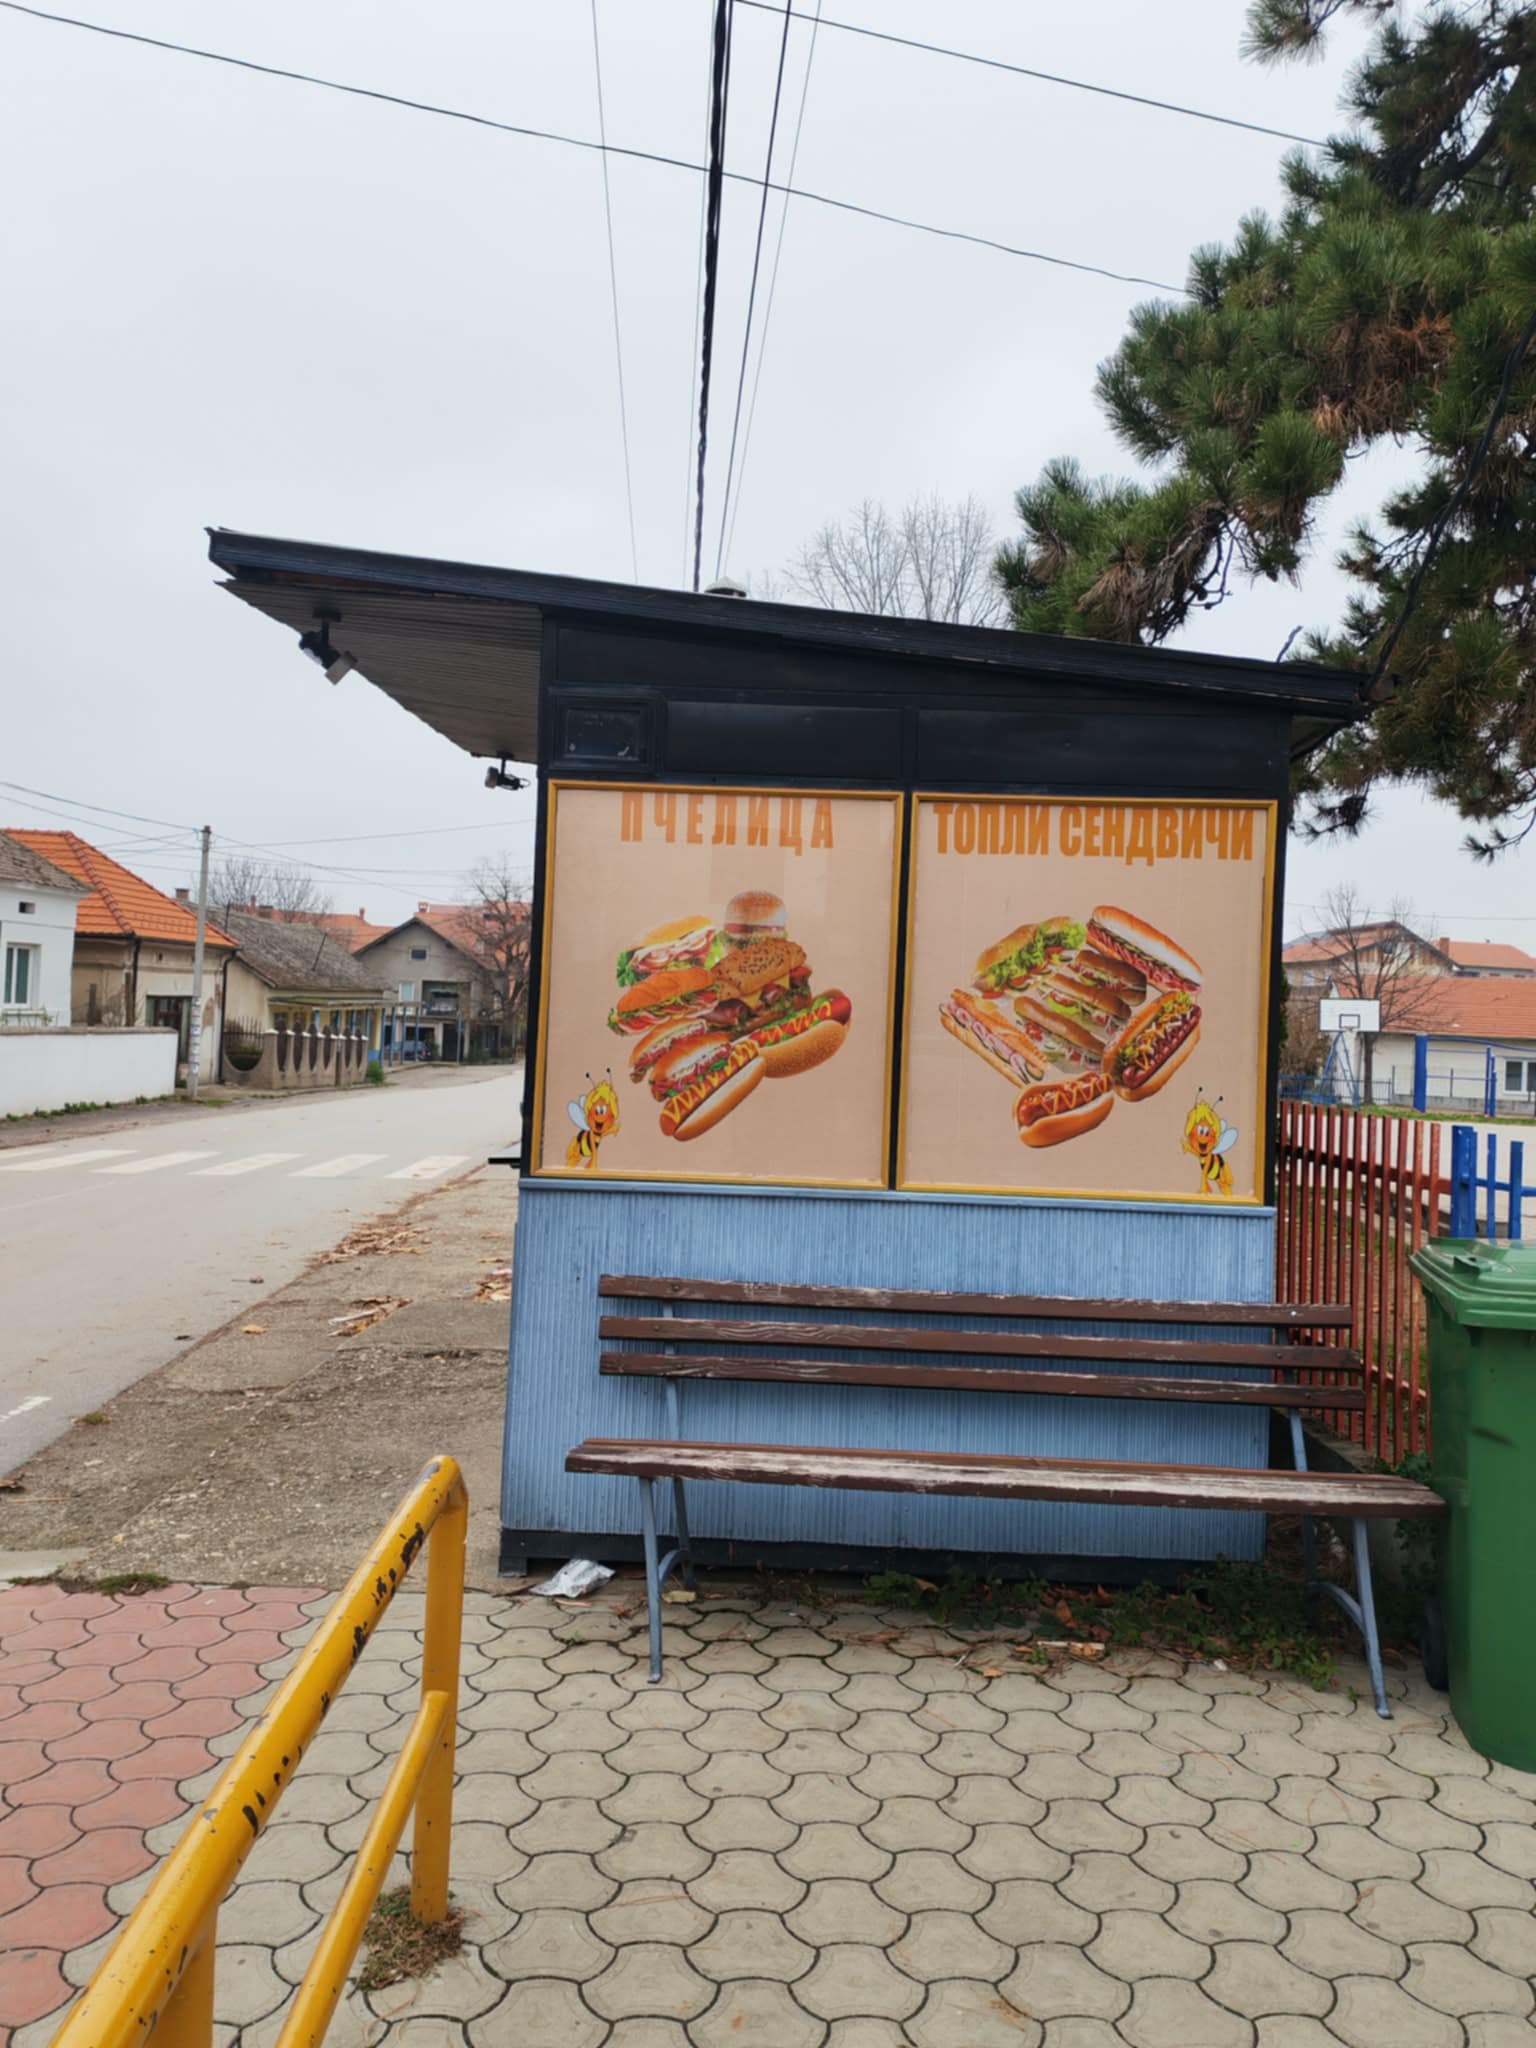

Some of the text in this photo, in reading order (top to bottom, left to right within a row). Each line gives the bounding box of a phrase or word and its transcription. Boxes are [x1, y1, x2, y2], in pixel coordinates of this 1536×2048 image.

[620, 791, 834, 856] ПЧЕЛИЦА
[933, 803, 1254, 866] ТОПЛИ СЕНДВИЧИ
